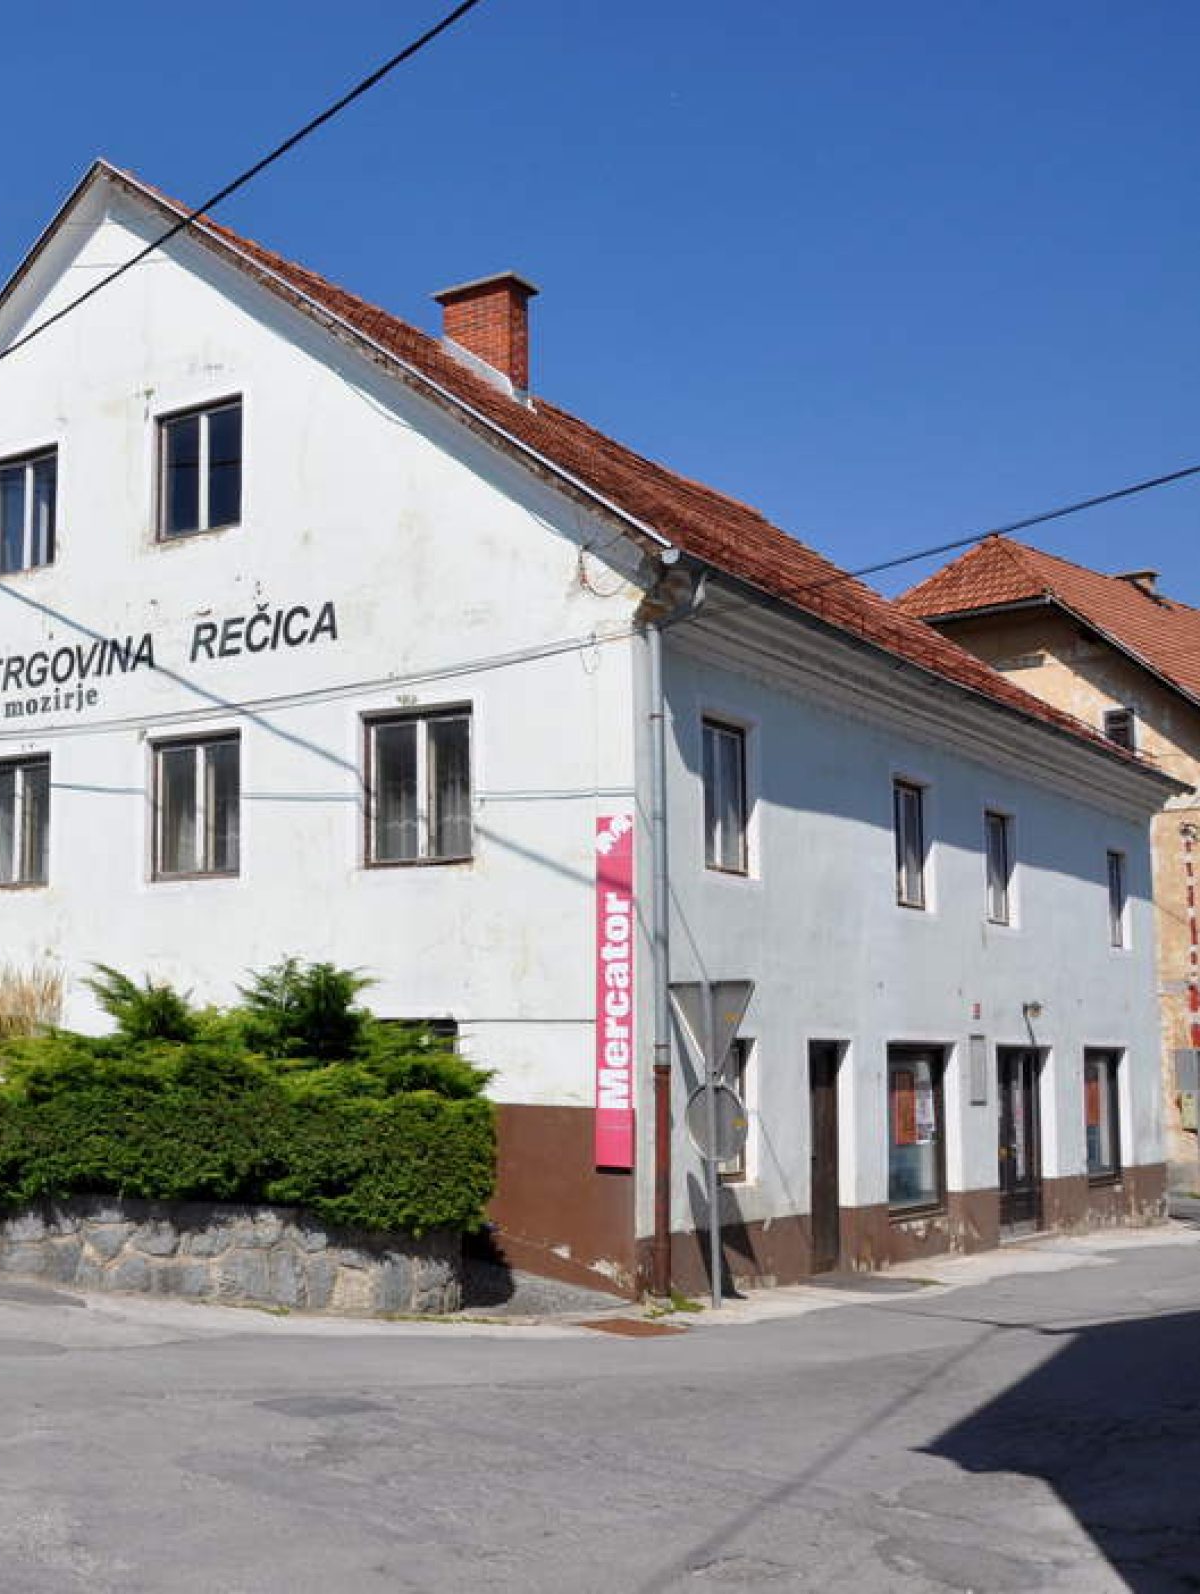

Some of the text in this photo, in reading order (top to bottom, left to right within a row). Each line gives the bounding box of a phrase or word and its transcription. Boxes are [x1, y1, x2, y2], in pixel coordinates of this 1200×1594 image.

[189, 601, 338, 663] REČICA
[5, 683, 98, 718] mozirje
[597, 892, 630, 1109] Mercator
